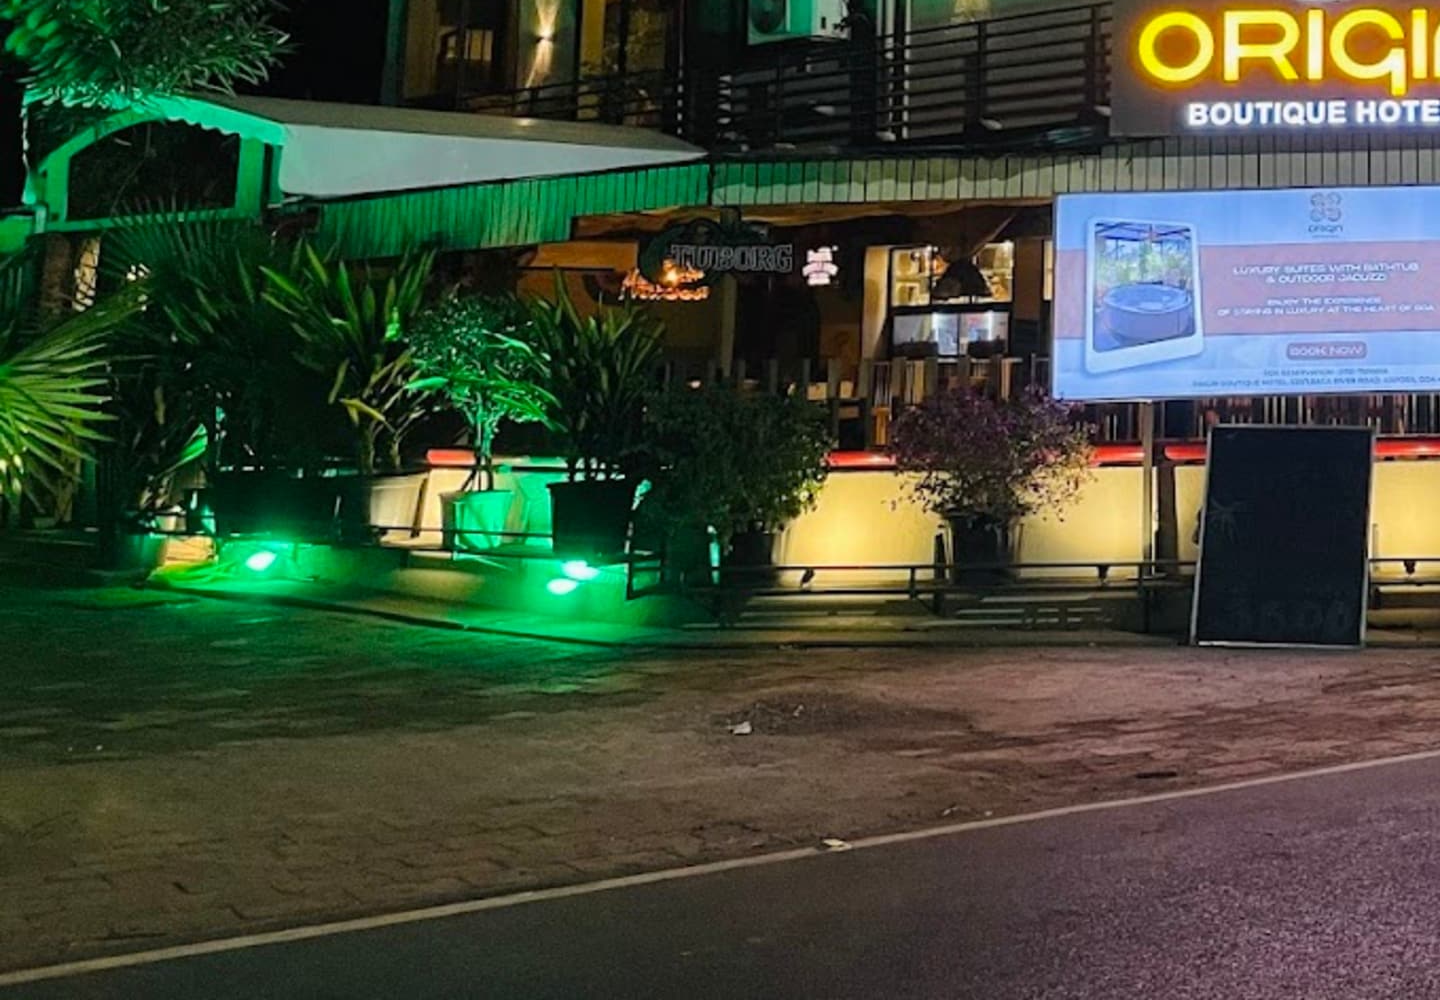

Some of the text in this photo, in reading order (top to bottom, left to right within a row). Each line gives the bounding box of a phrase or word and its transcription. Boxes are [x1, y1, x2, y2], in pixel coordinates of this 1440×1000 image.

[1188, 102, 1347, 126] BOUTIQUE
[671, 244, 793, 273] TUBORG
[1328, 263, 1361, 273] WITH
[1363, 262, 1419, 272] BATHTUB
[1278, 274, 1335, 283] OUTDOOR
[1302, 297, 1321, 305] THE
[1290, 345, 1363, 356] BOOK NOW
